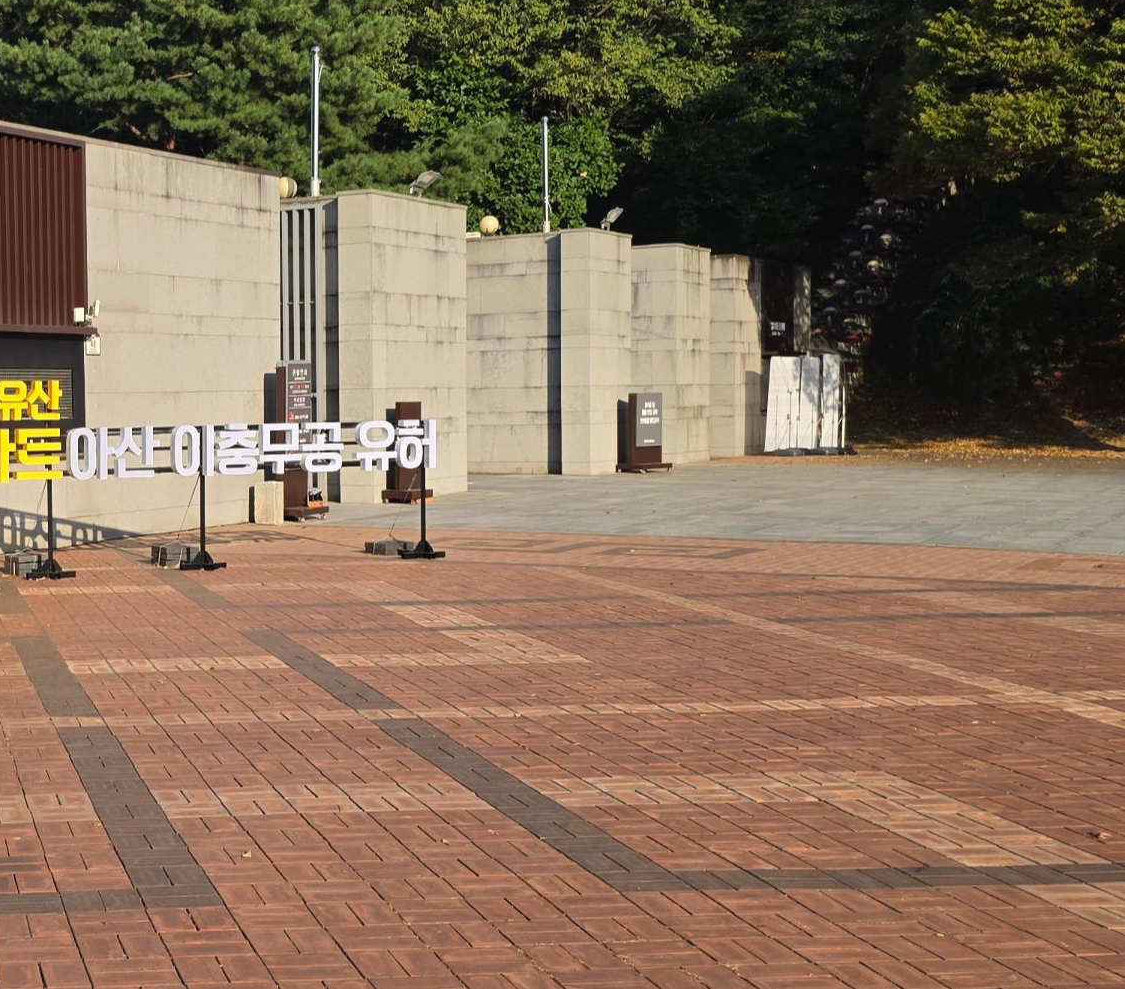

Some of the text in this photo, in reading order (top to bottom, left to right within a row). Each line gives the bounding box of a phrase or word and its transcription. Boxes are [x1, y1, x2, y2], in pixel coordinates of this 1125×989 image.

[66, 418, 437, 481] 아산 이충무공 유허
